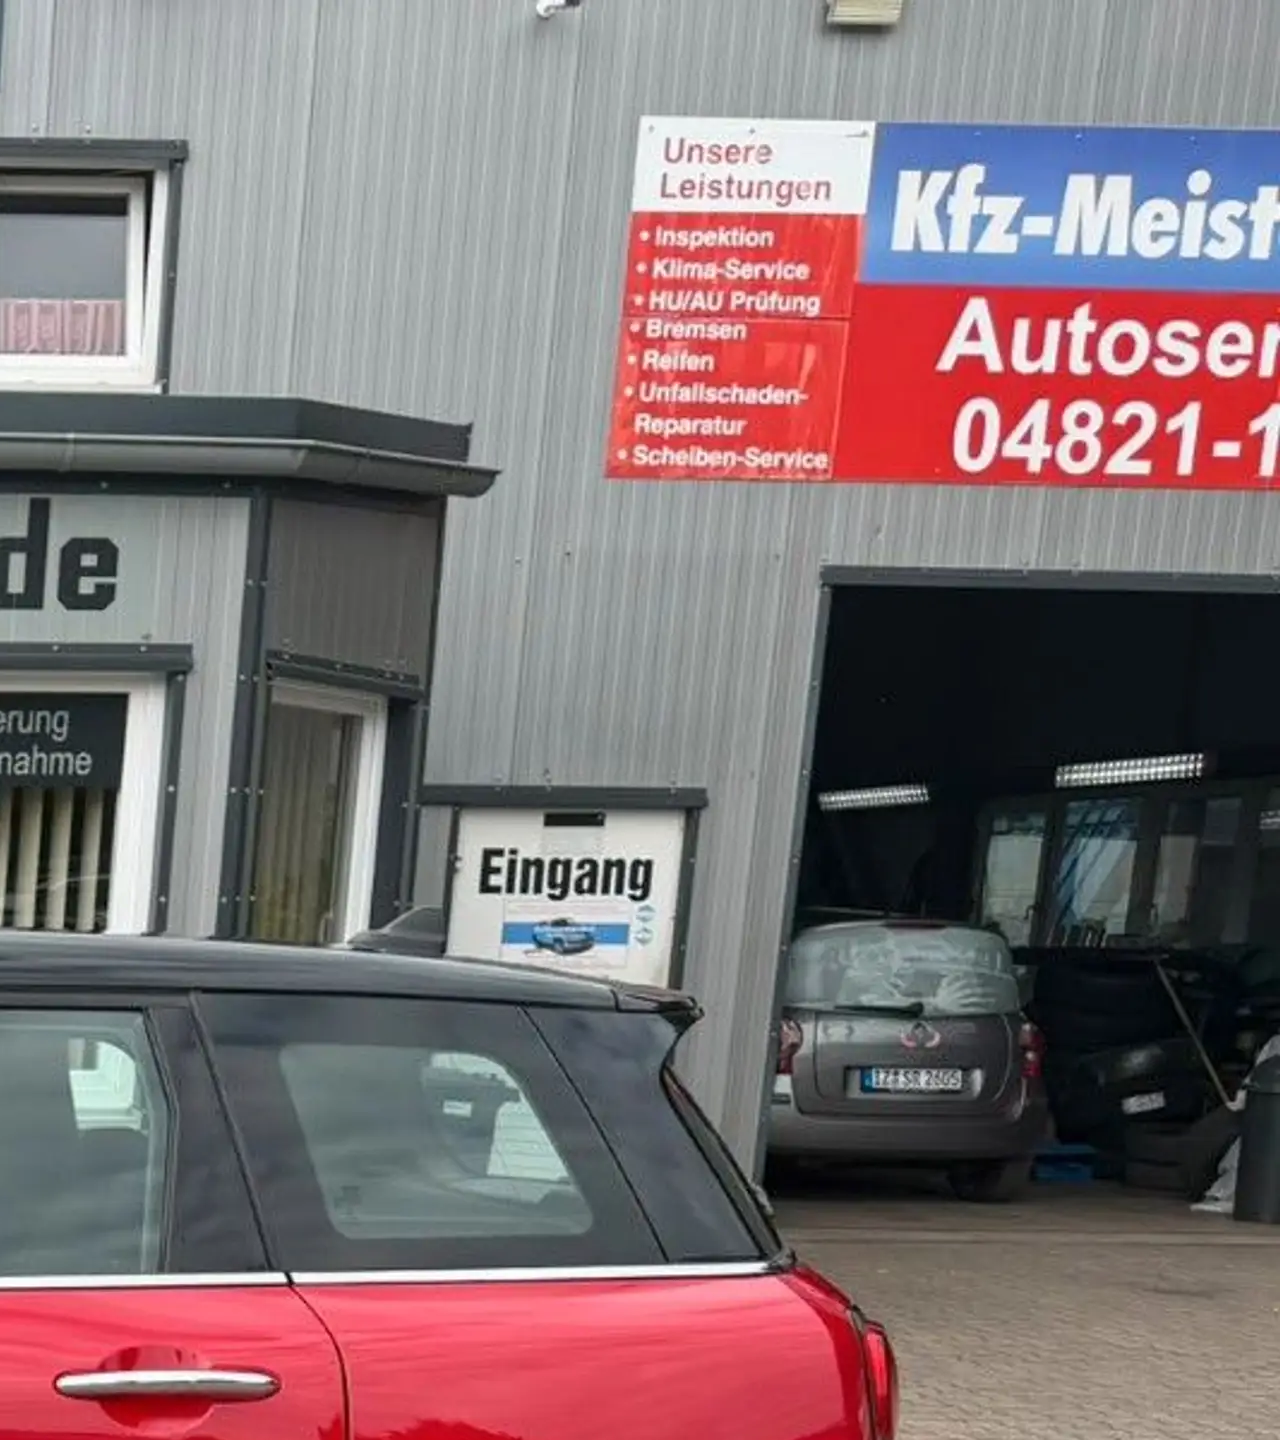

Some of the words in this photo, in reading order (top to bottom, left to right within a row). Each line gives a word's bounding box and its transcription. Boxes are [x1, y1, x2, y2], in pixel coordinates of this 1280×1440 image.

[664, 137, 774, 165] Unsere
[659, 172, 832, 208] Leistungen
[891, 163, 1280, 260] Kfz-Meist
[654, 225, 775, 250] Inspektion
[652, 256, 811, 281] Klima-Service
[649, 290, 724, 312] HU/AU
[730, 291, 821, 316] Prüfung
[645, 318, 748, 341] Bremsen
[642, 349, 716, 373] Reifen
[639, 380, 810, 406] Unfallschaden-
[634, 412, 748, 440] Reparatur
[952, 396, 1280, 478] 04821-1
[631, 444, 830, 471] Scheiben-Service
[478, 847, 654, 902] Eingang
